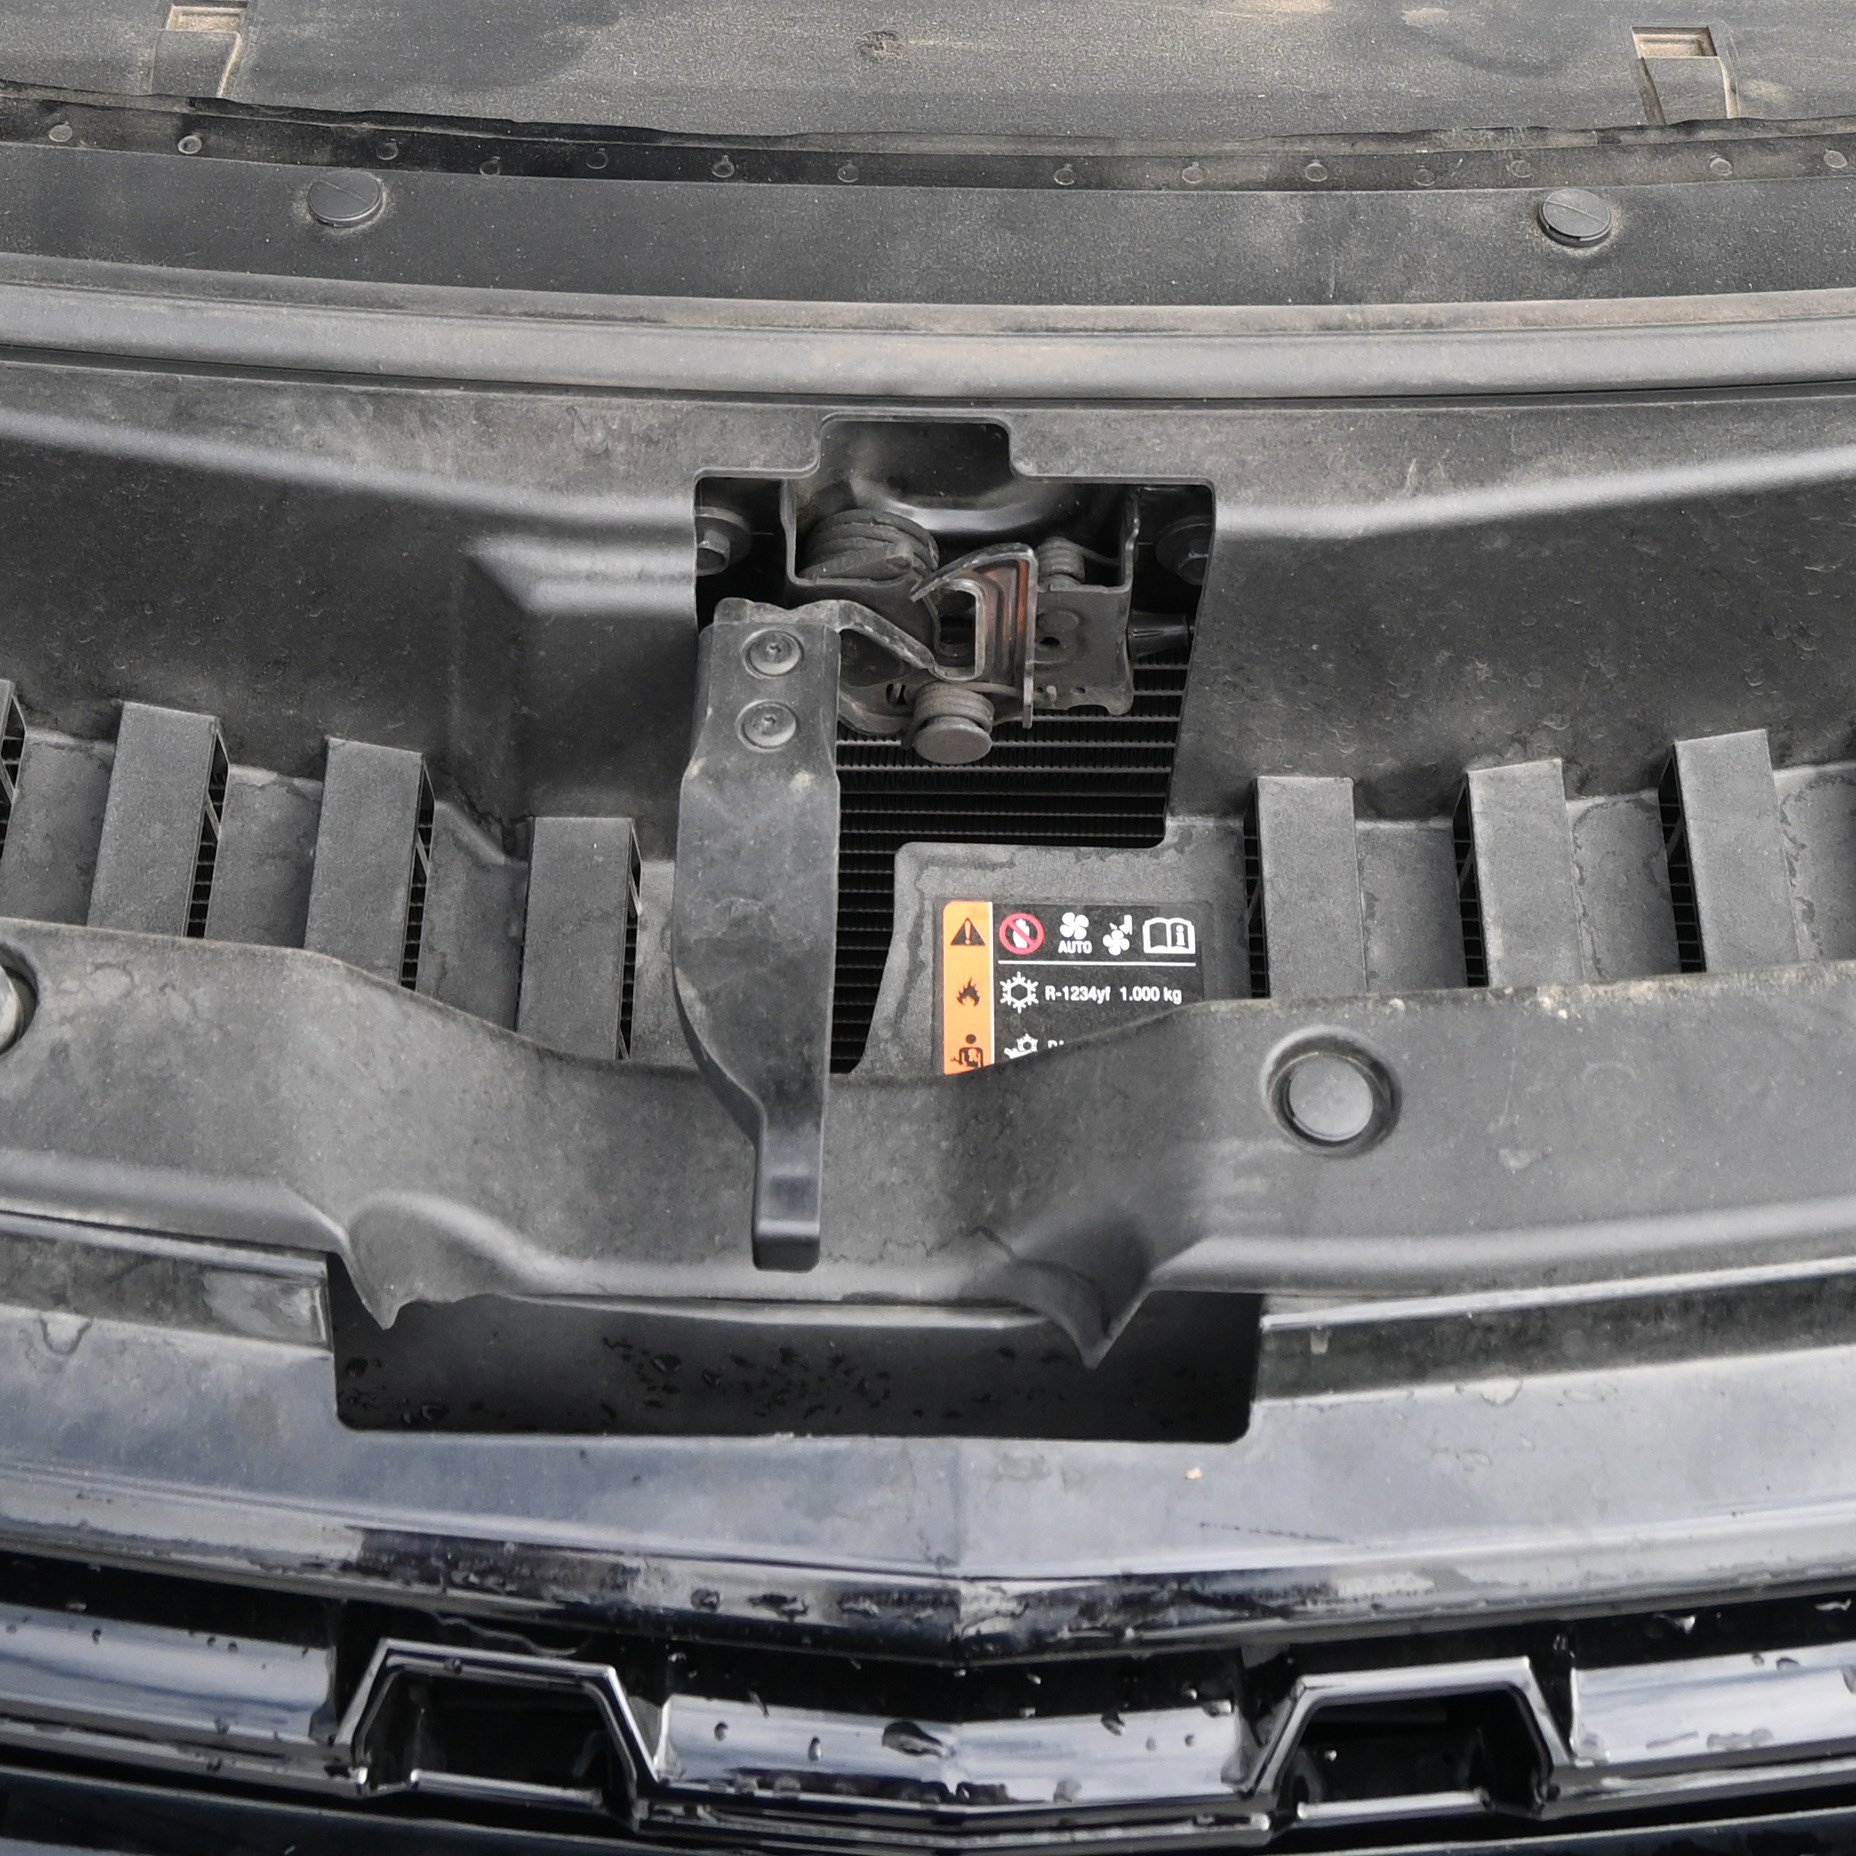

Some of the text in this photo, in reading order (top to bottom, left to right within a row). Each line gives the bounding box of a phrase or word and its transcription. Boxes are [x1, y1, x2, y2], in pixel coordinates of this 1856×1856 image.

[1058, 940, 1093, 954] AUTO
[1044, 985, 1183, 1005] R-1234yf 1.000 kg
